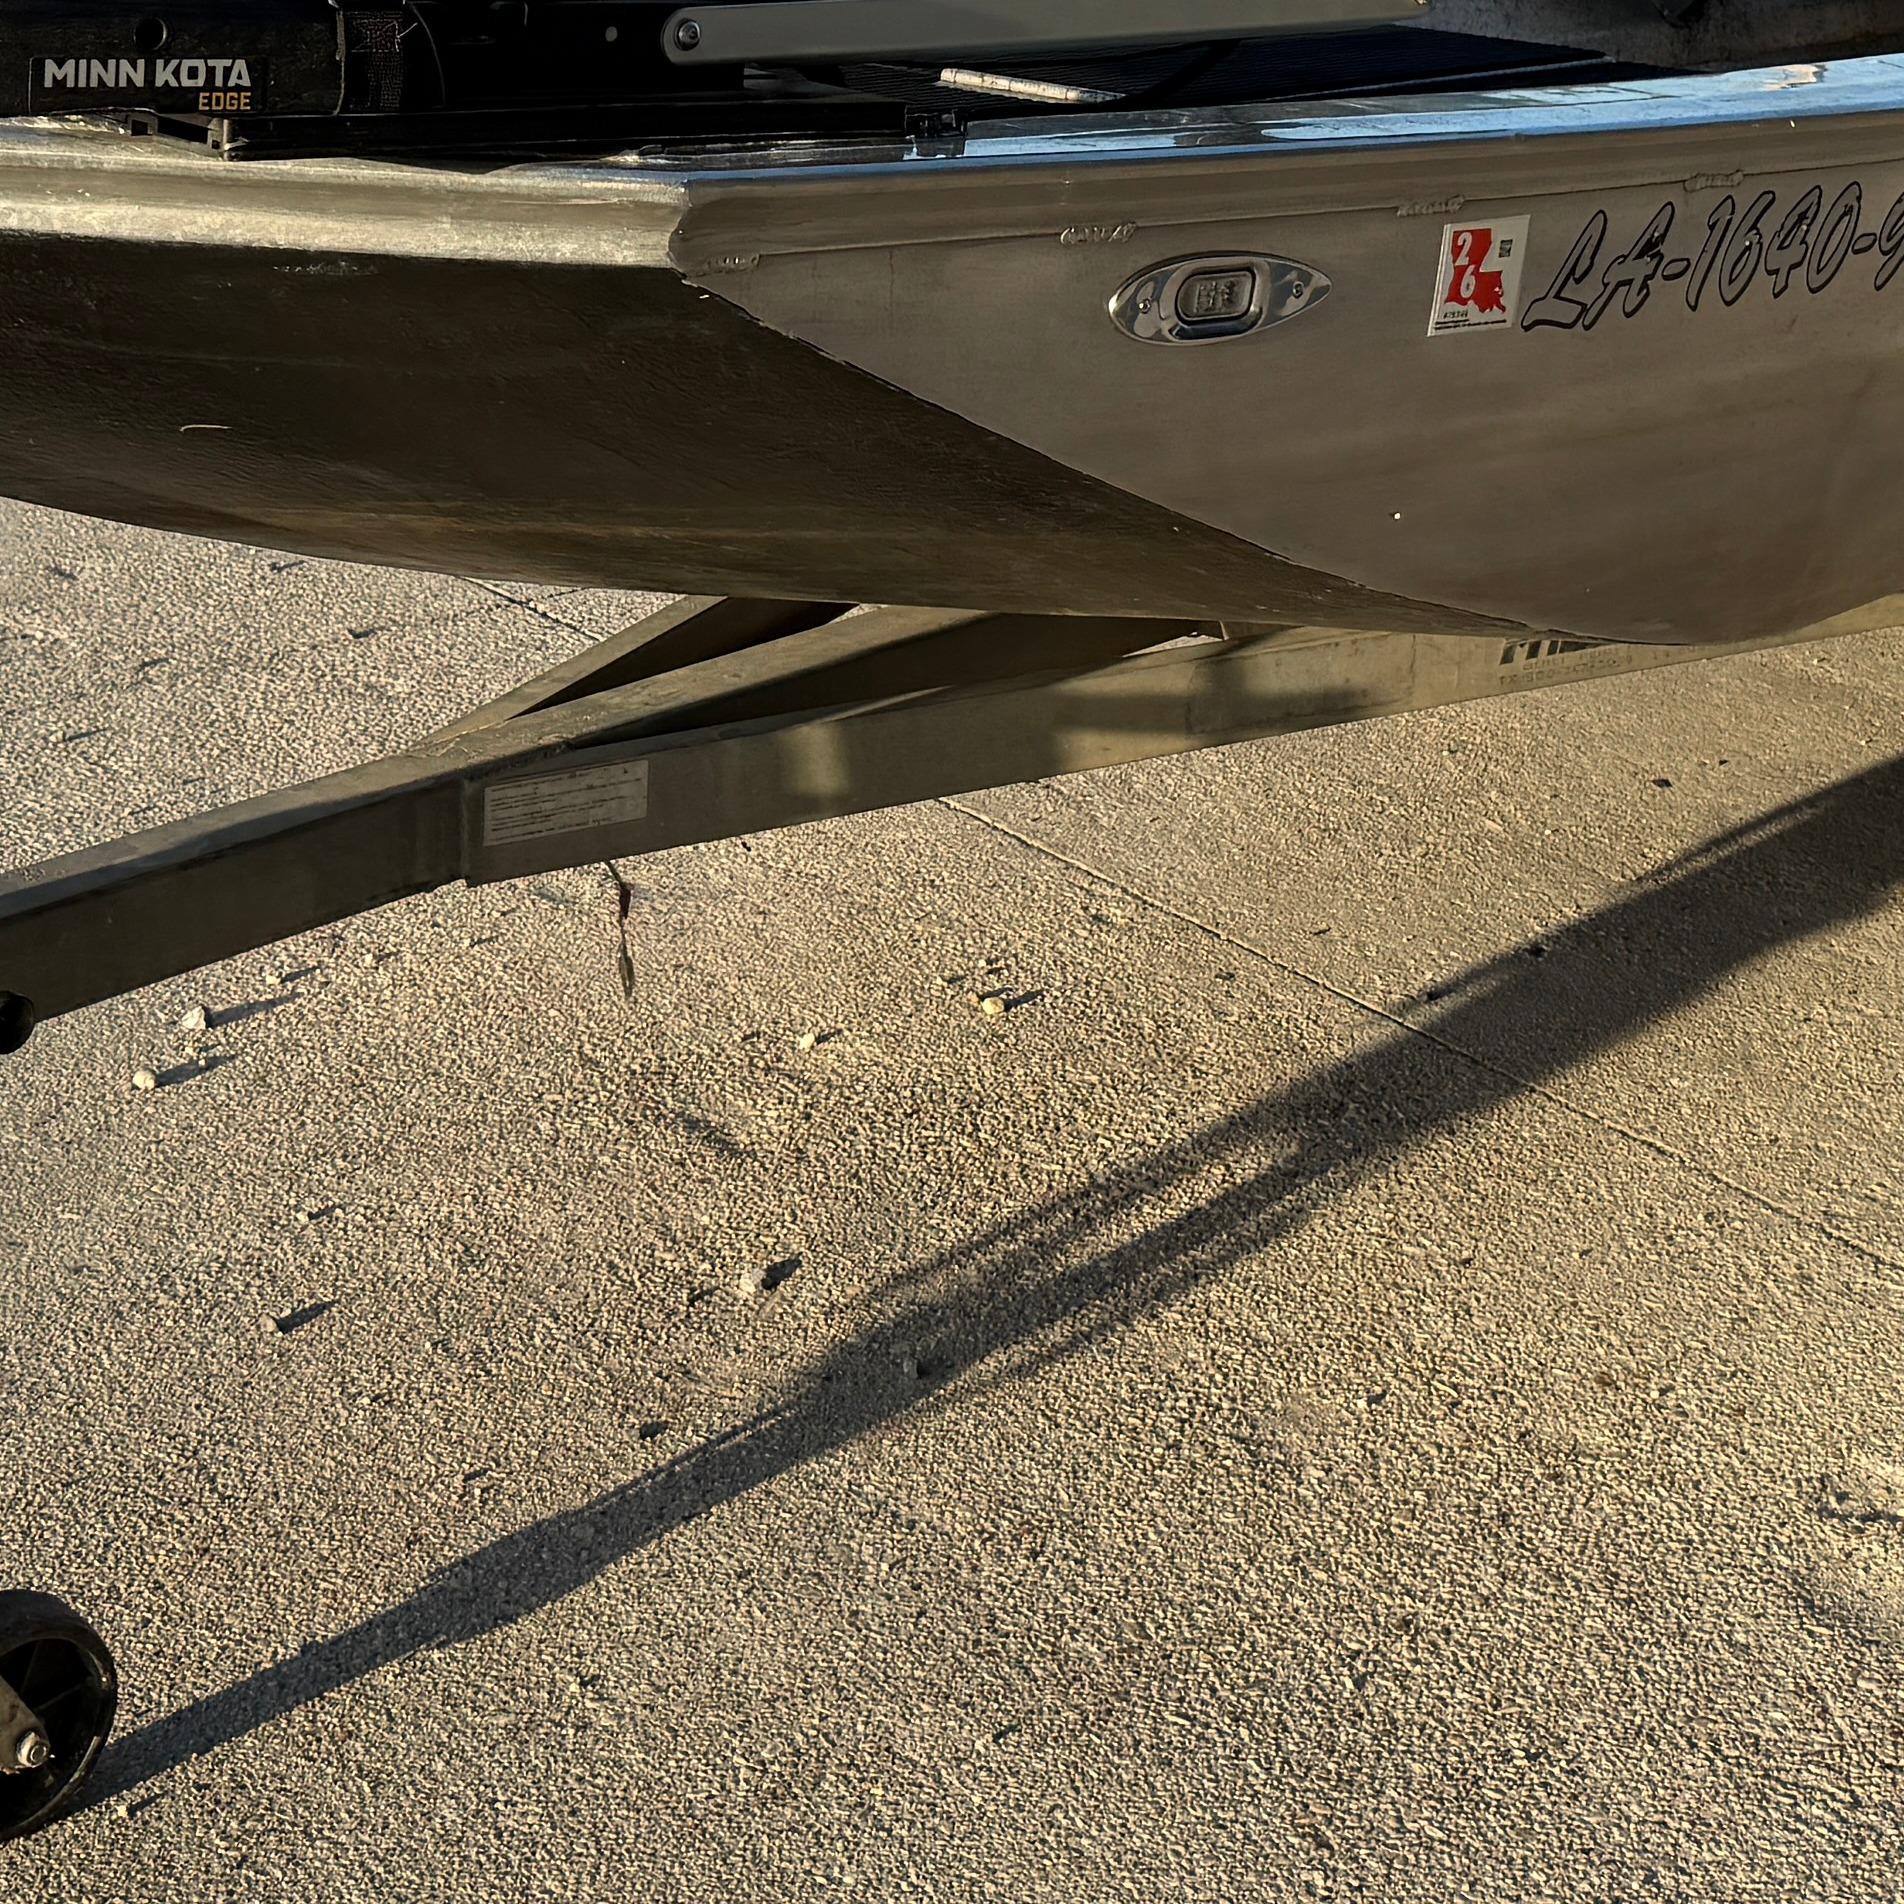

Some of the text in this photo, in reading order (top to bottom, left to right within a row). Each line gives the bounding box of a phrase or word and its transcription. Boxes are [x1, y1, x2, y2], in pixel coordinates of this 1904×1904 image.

[43, 58, 253, 88] MINN KOTA
[198, 91, 253, 111] EDGE
